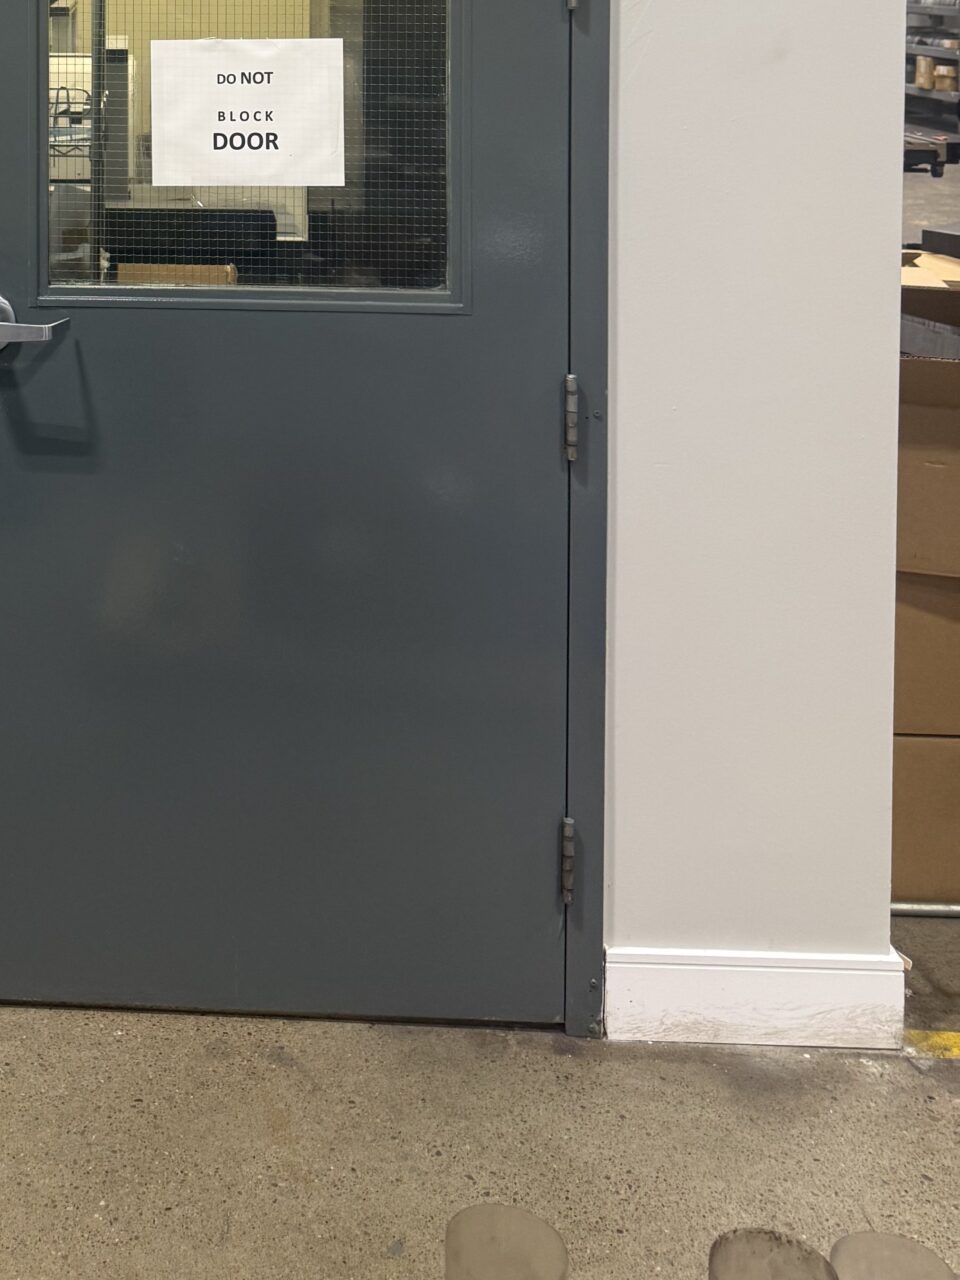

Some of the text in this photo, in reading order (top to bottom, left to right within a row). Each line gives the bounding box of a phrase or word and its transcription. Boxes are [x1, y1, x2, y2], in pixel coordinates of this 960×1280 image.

[217, 71, 274, 85] DO NOT
[217, 110, 274, 122] BLOCK
[212, 132, 280, 151] DOOR
